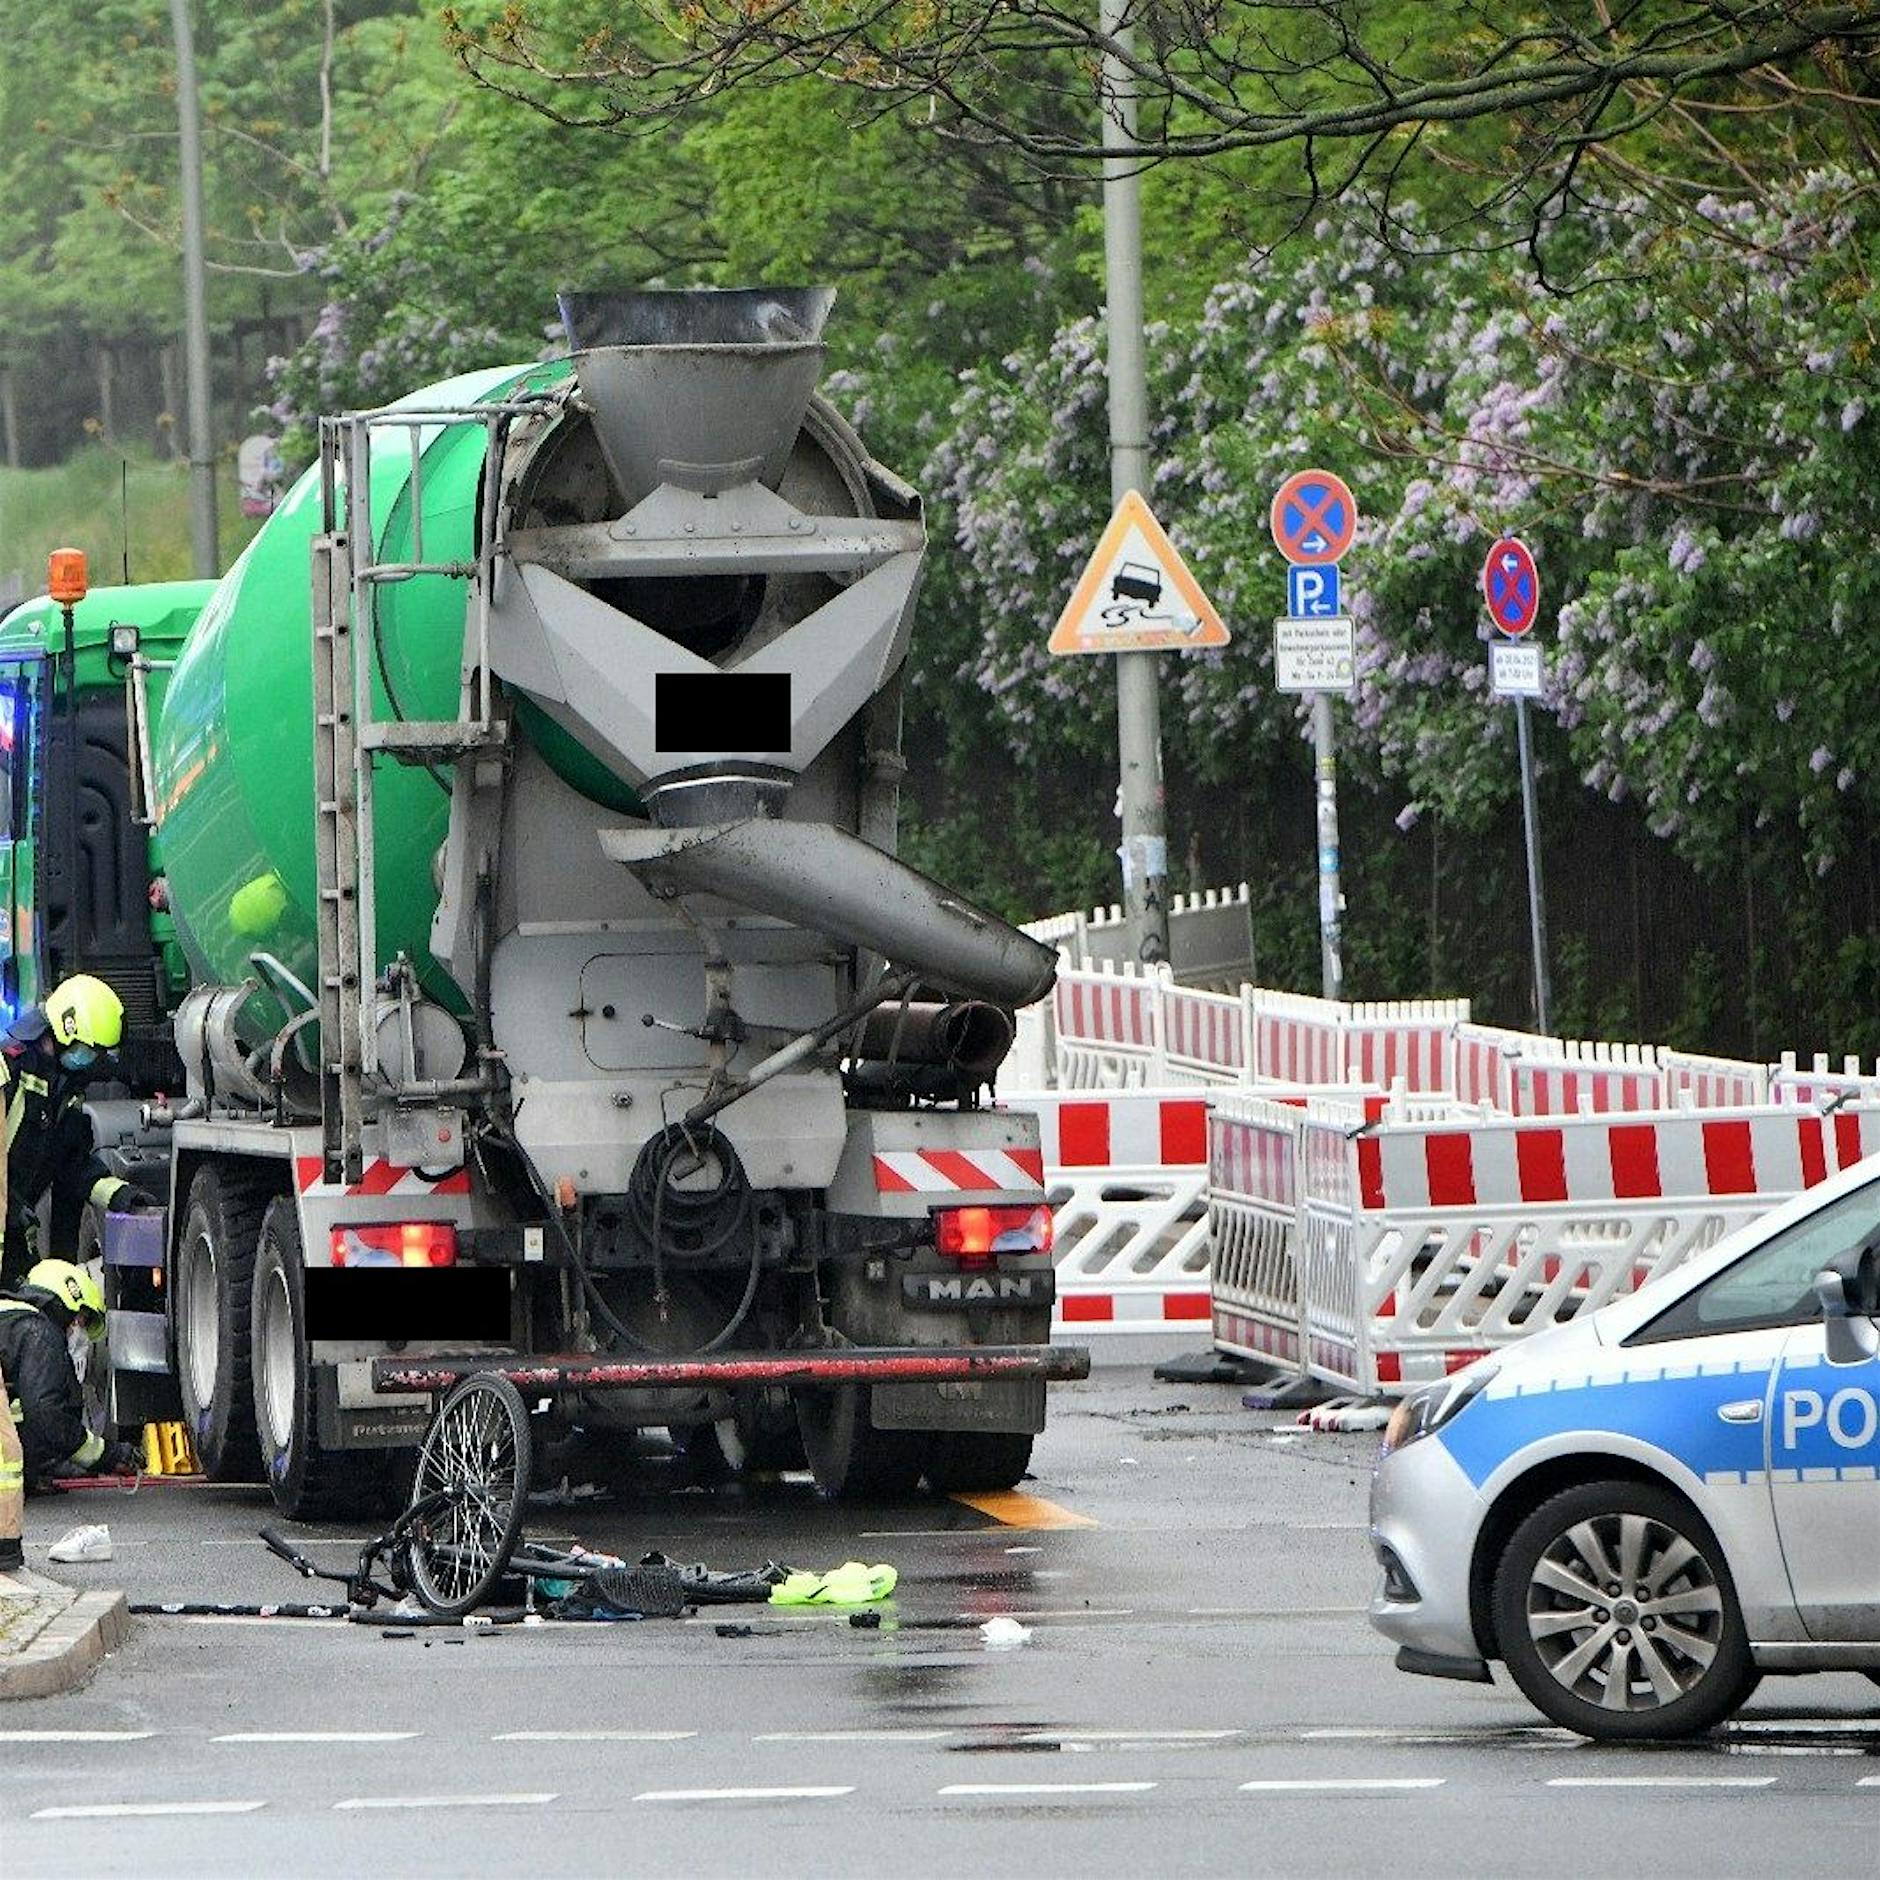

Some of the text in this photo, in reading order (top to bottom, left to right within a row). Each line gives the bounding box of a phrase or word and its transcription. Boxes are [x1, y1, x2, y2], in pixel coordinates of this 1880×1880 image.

[1296, 570, 1324, 616] P
[929, 1277, 1032, 1300] MAN
[1783, 1387, 1878, 1450] PO
